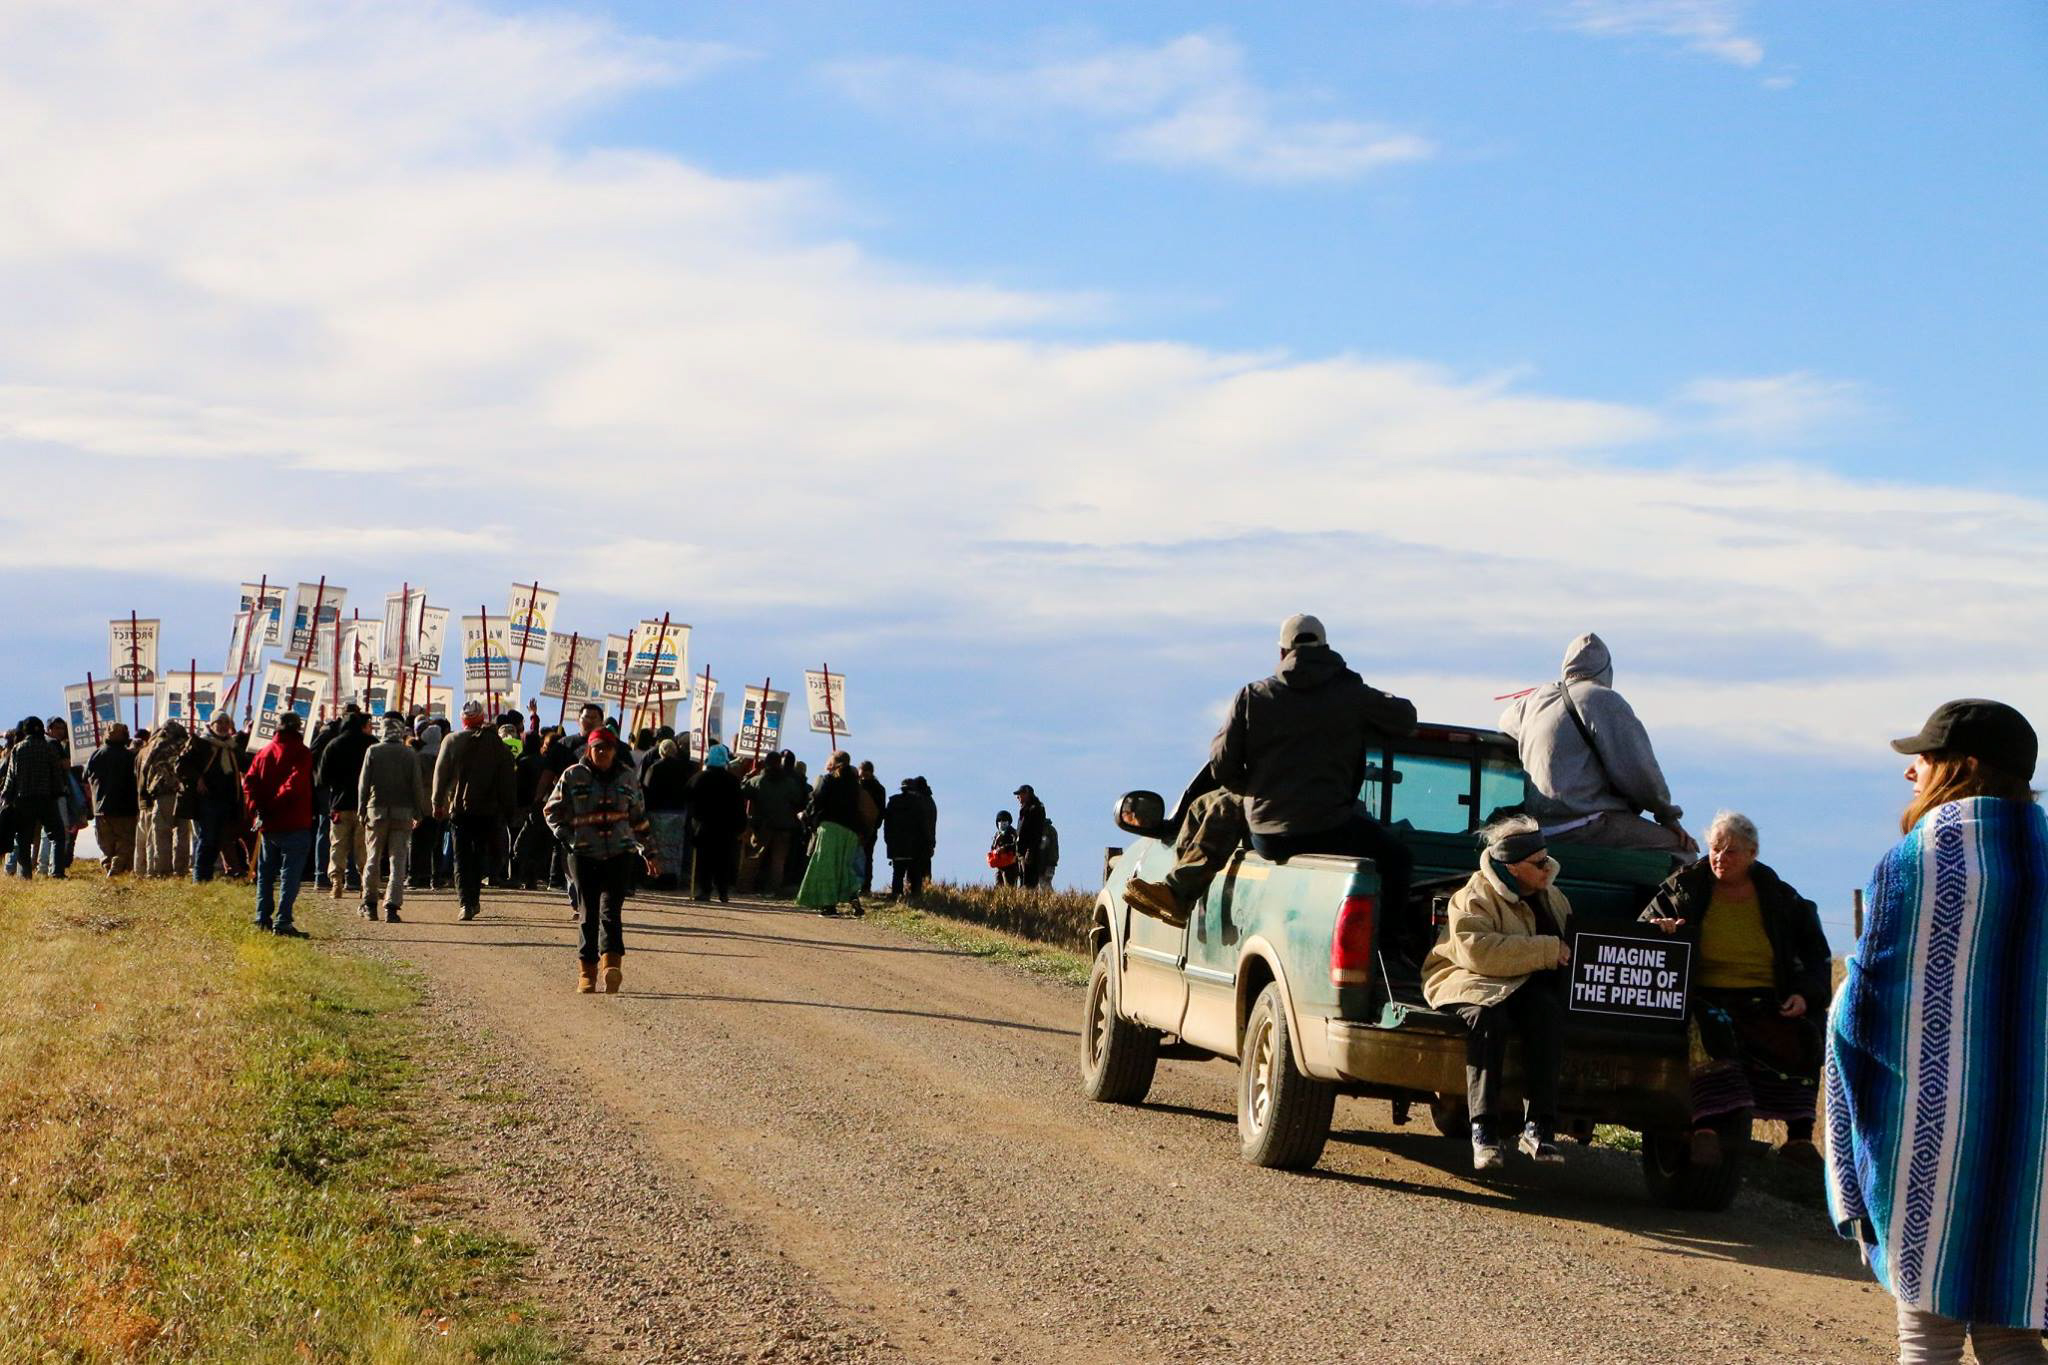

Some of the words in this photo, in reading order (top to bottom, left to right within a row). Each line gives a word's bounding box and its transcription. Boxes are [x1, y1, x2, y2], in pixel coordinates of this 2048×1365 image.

[1598, 945, 1667, 969] IMAGINE
[1583, 964, 1615, 984] THE
[1620, 967, 1653, 987] END
[1656, 970, 1679, 989] OF
[1574, 982, 1607, 1003] THE
[1610, 987, 1684, 1010] PIPELINE
